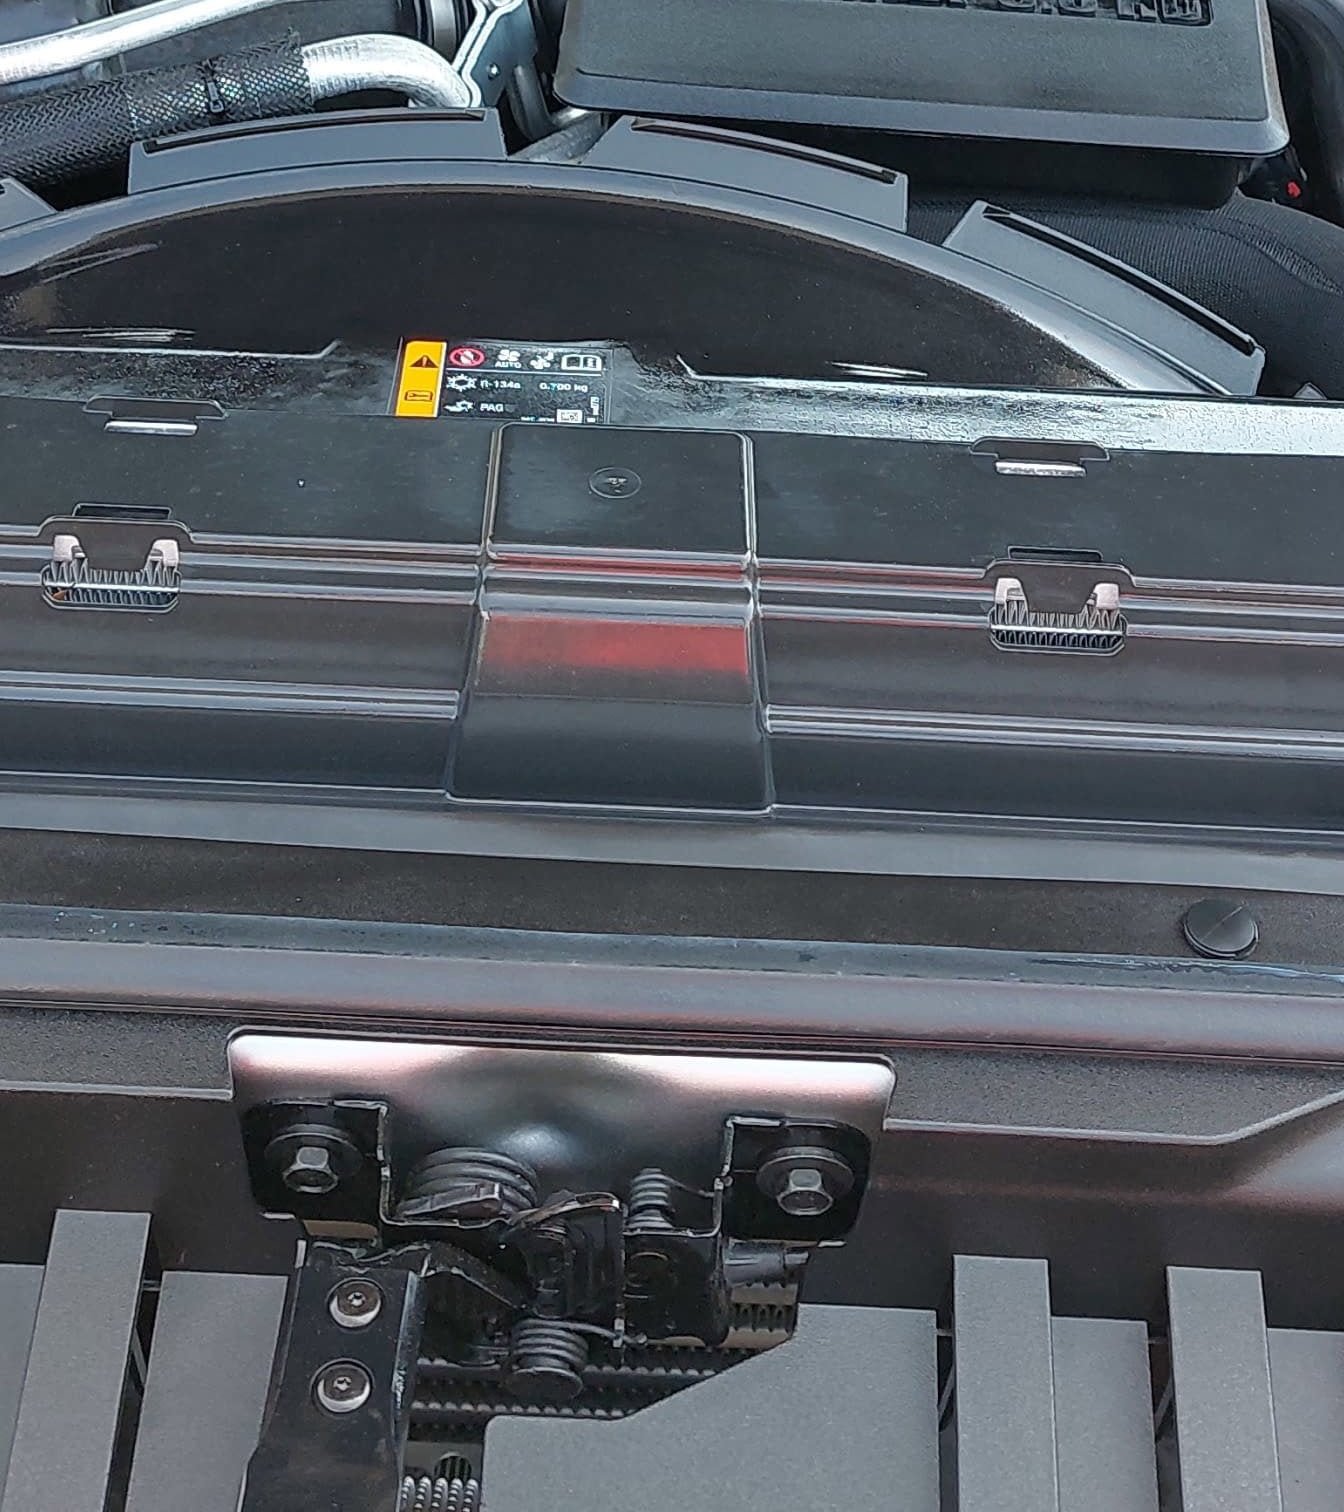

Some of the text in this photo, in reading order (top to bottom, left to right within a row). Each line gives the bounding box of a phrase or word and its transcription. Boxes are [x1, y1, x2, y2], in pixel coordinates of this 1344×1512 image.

[494, 360, 522, 369] AUTO
[479, 379, 521, 389] R-134a
[479, 402, 504, 413] PAG
